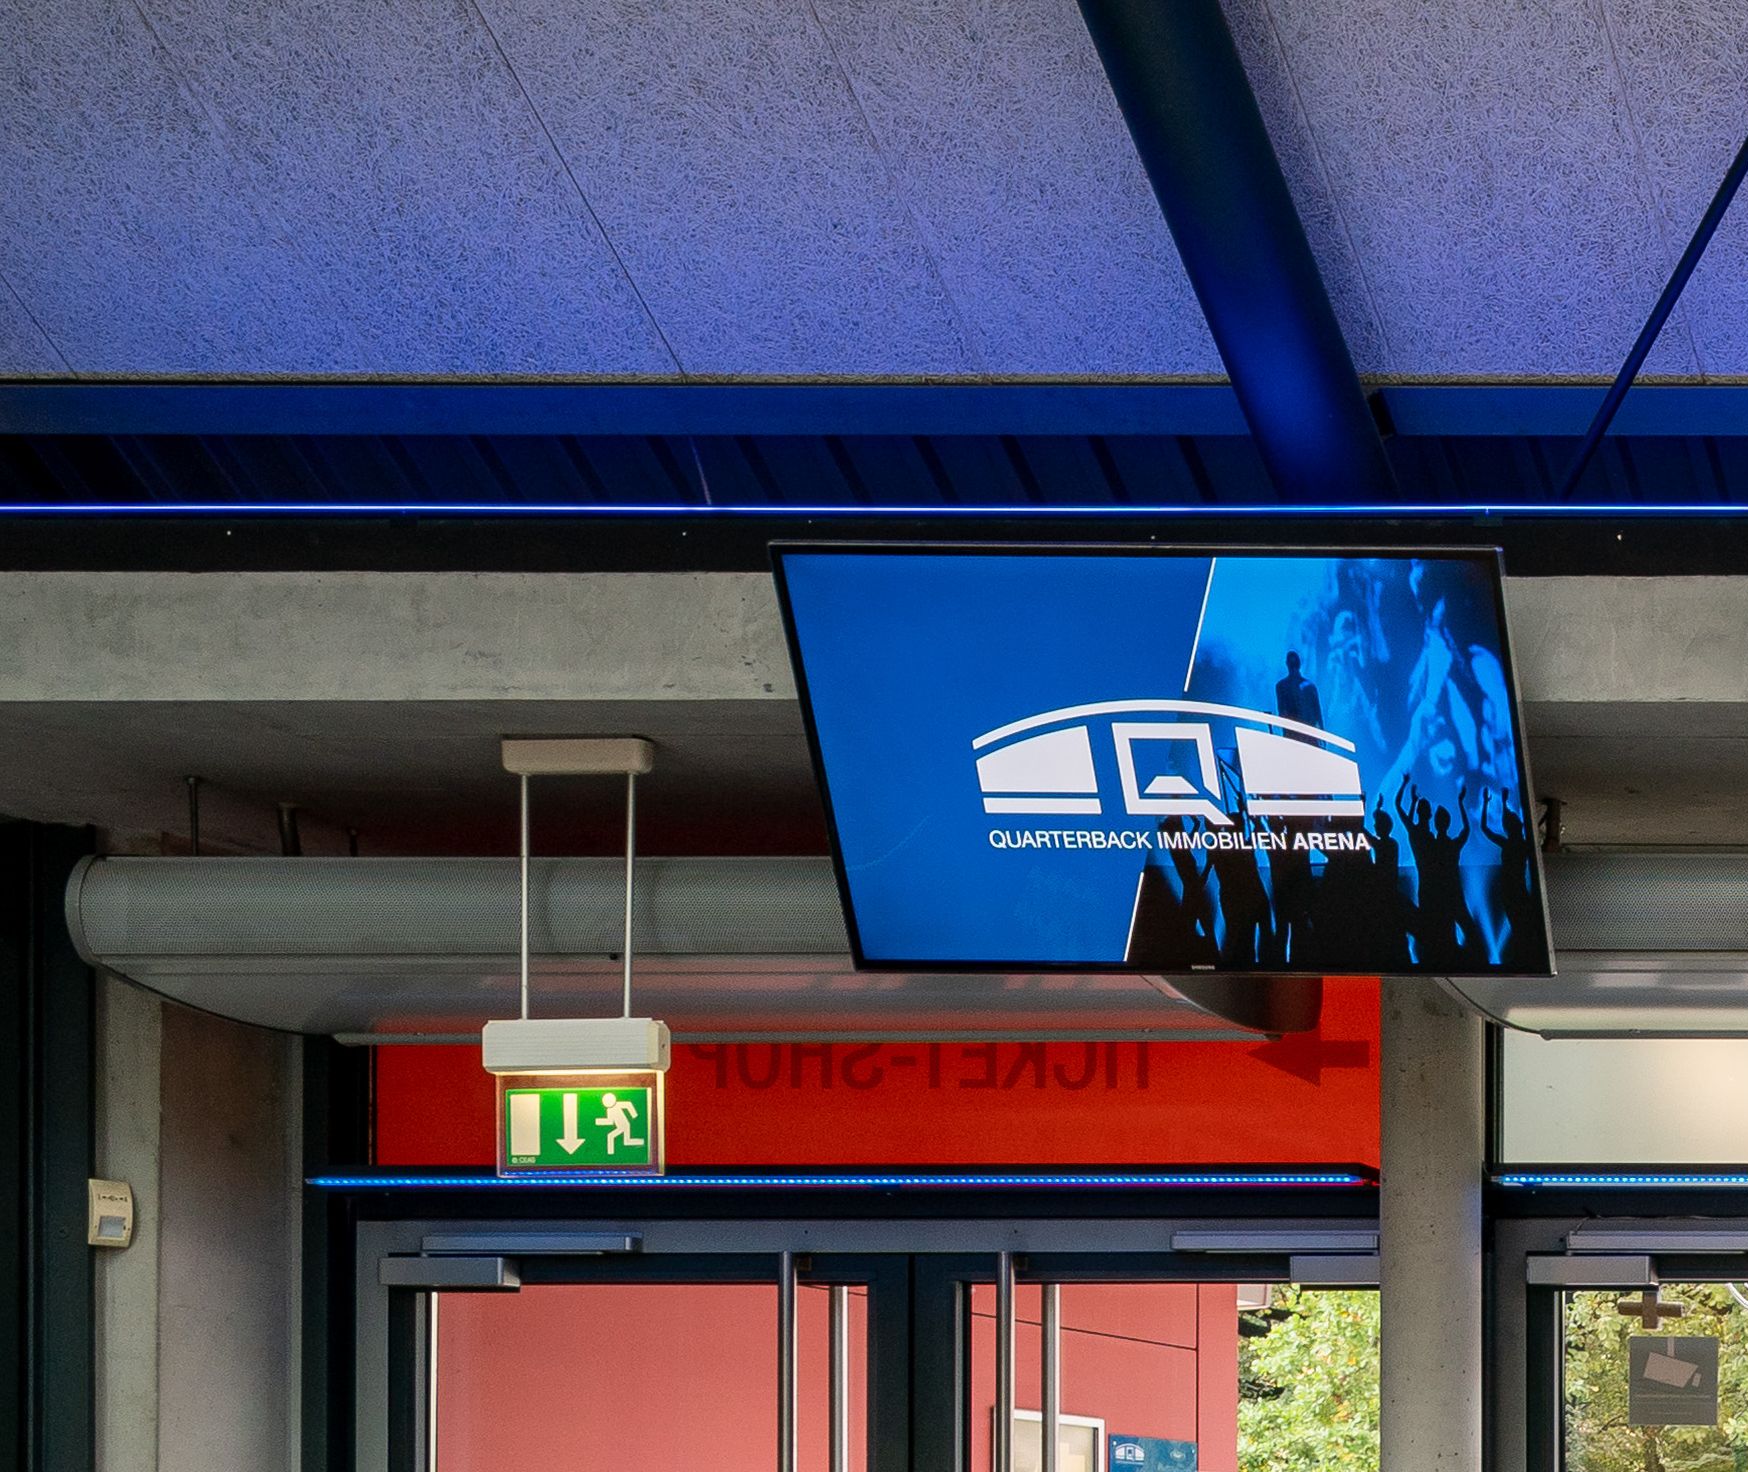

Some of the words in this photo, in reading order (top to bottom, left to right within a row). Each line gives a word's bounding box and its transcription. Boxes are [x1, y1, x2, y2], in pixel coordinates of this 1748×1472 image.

[988, 829, 1153, 850] QUARTERBACK
[1157, 830, 1287, 850] IMMOBILIEN
[1292, 832, 1371, 851] ARENA
